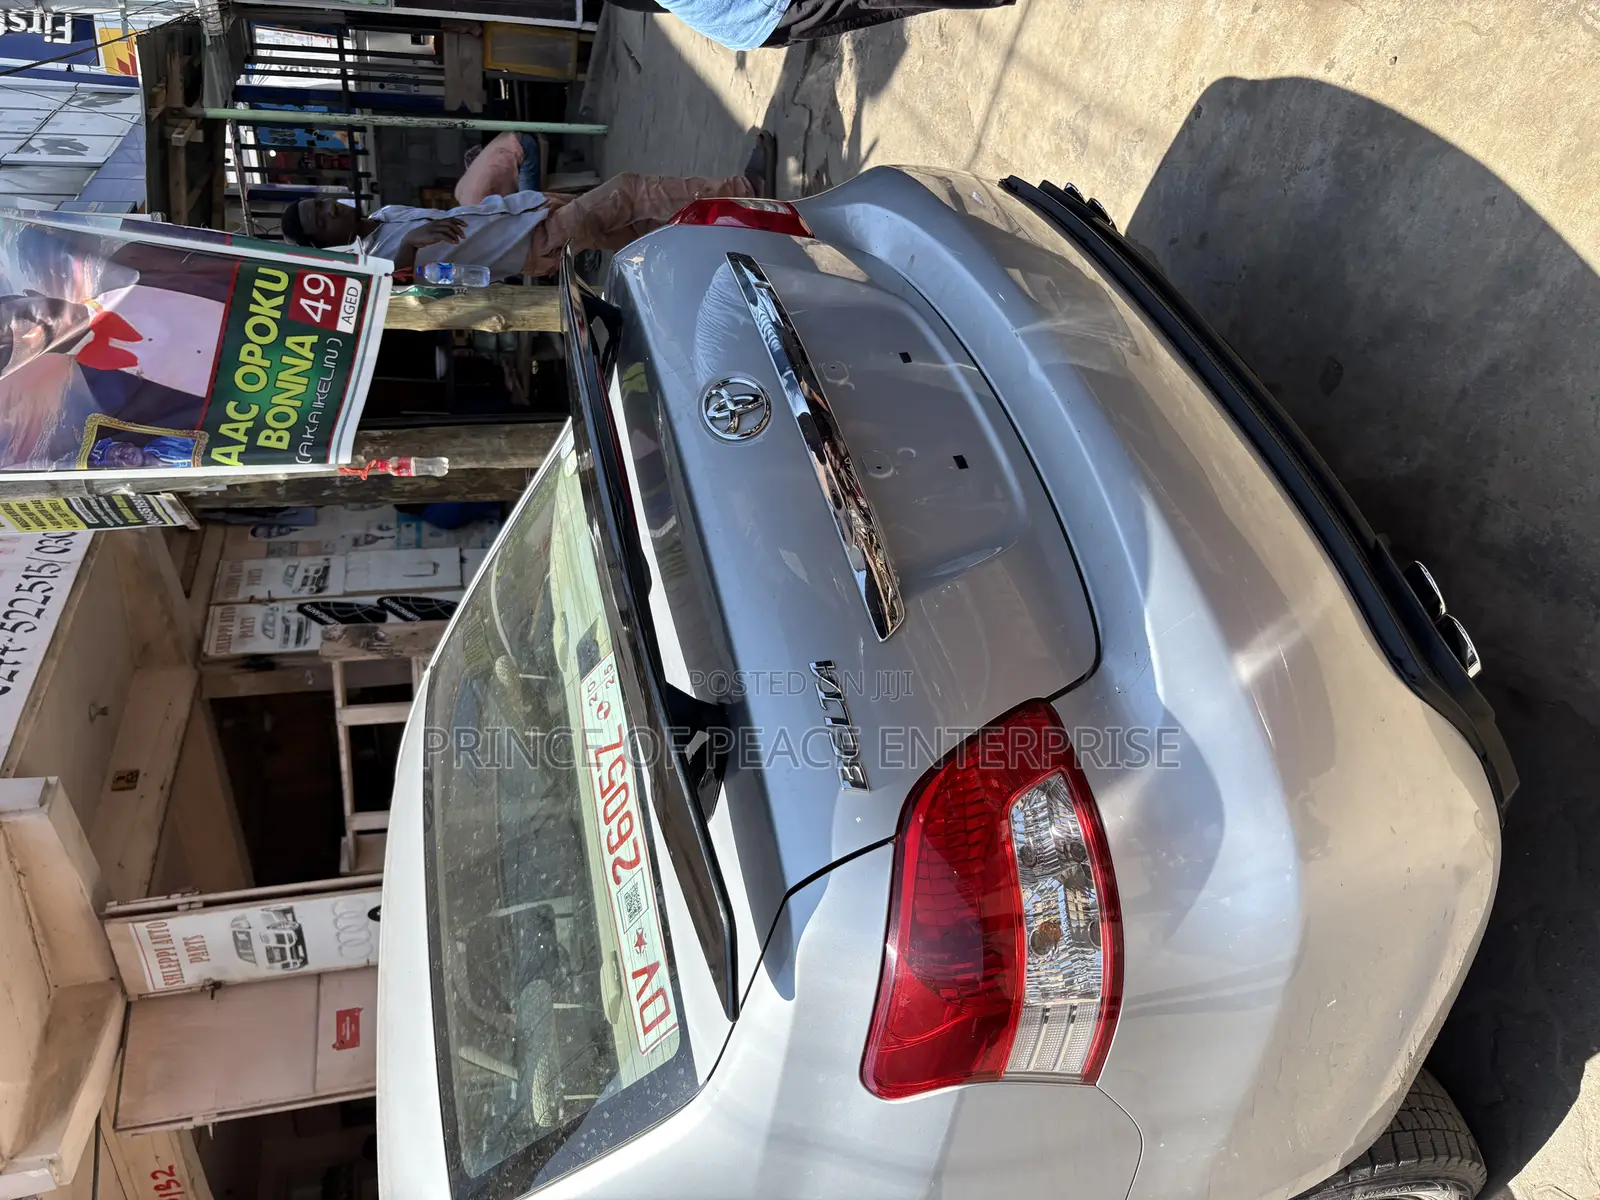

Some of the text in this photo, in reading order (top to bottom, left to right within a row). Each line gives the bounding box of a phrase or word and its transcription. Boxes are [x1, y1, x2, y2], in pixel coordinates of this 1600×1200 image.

[299, 273, 336, 323] 49
[341, 286, 359, 325] AGED
[234, 266, 289, 393] OPOKU
[256, 335, 319, 450] BONNA
[587, 681, 598, 706] 20
[603, 664, 615, 689] 25
[808, 660, 870, 792] BELTA
[145, 921, 174, 945] AUTO
[182, 935, 210, 964] PARTS
[631, 960, 671, 1037] DV
